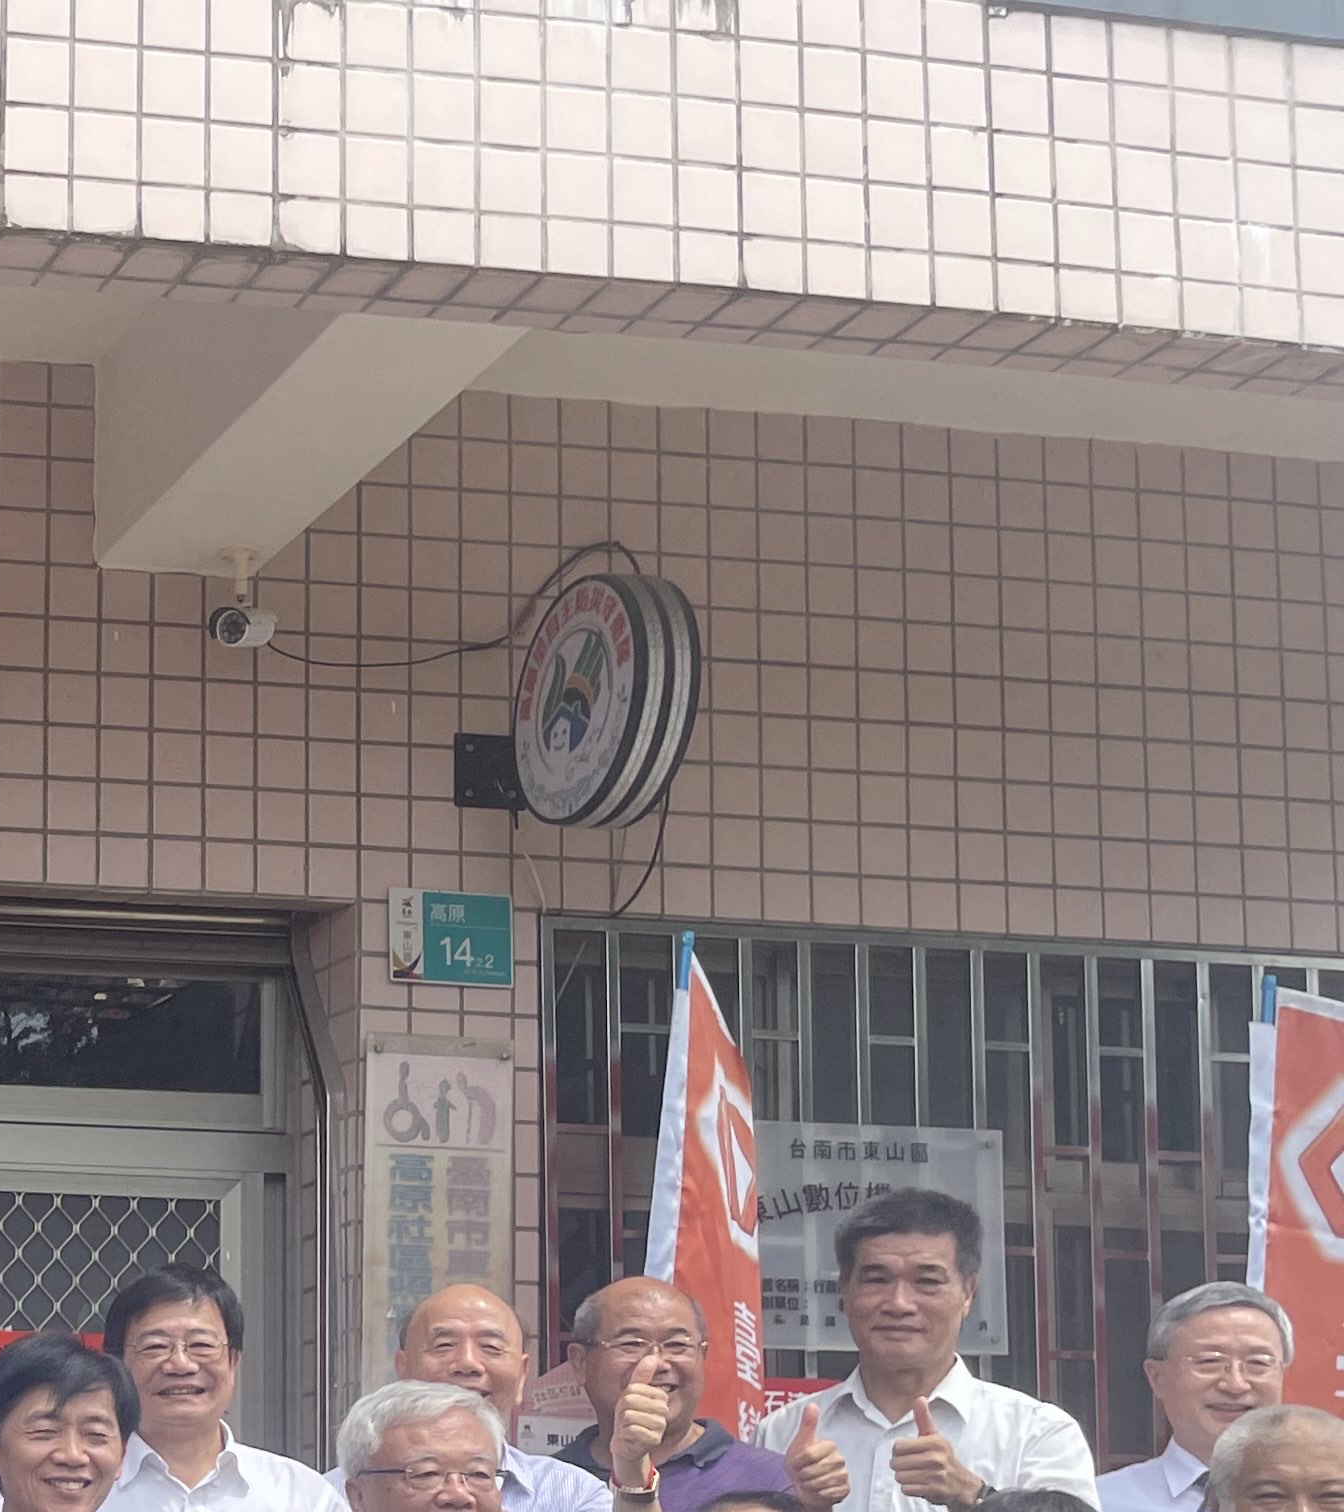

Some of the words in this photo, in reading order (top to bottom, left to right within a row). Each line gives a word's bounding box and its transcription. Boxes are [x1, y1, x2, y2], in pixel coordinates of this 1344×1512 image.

[430, 904, 465, 923] 高原
[790, 1138, 929, 1164] 台南市東山區
